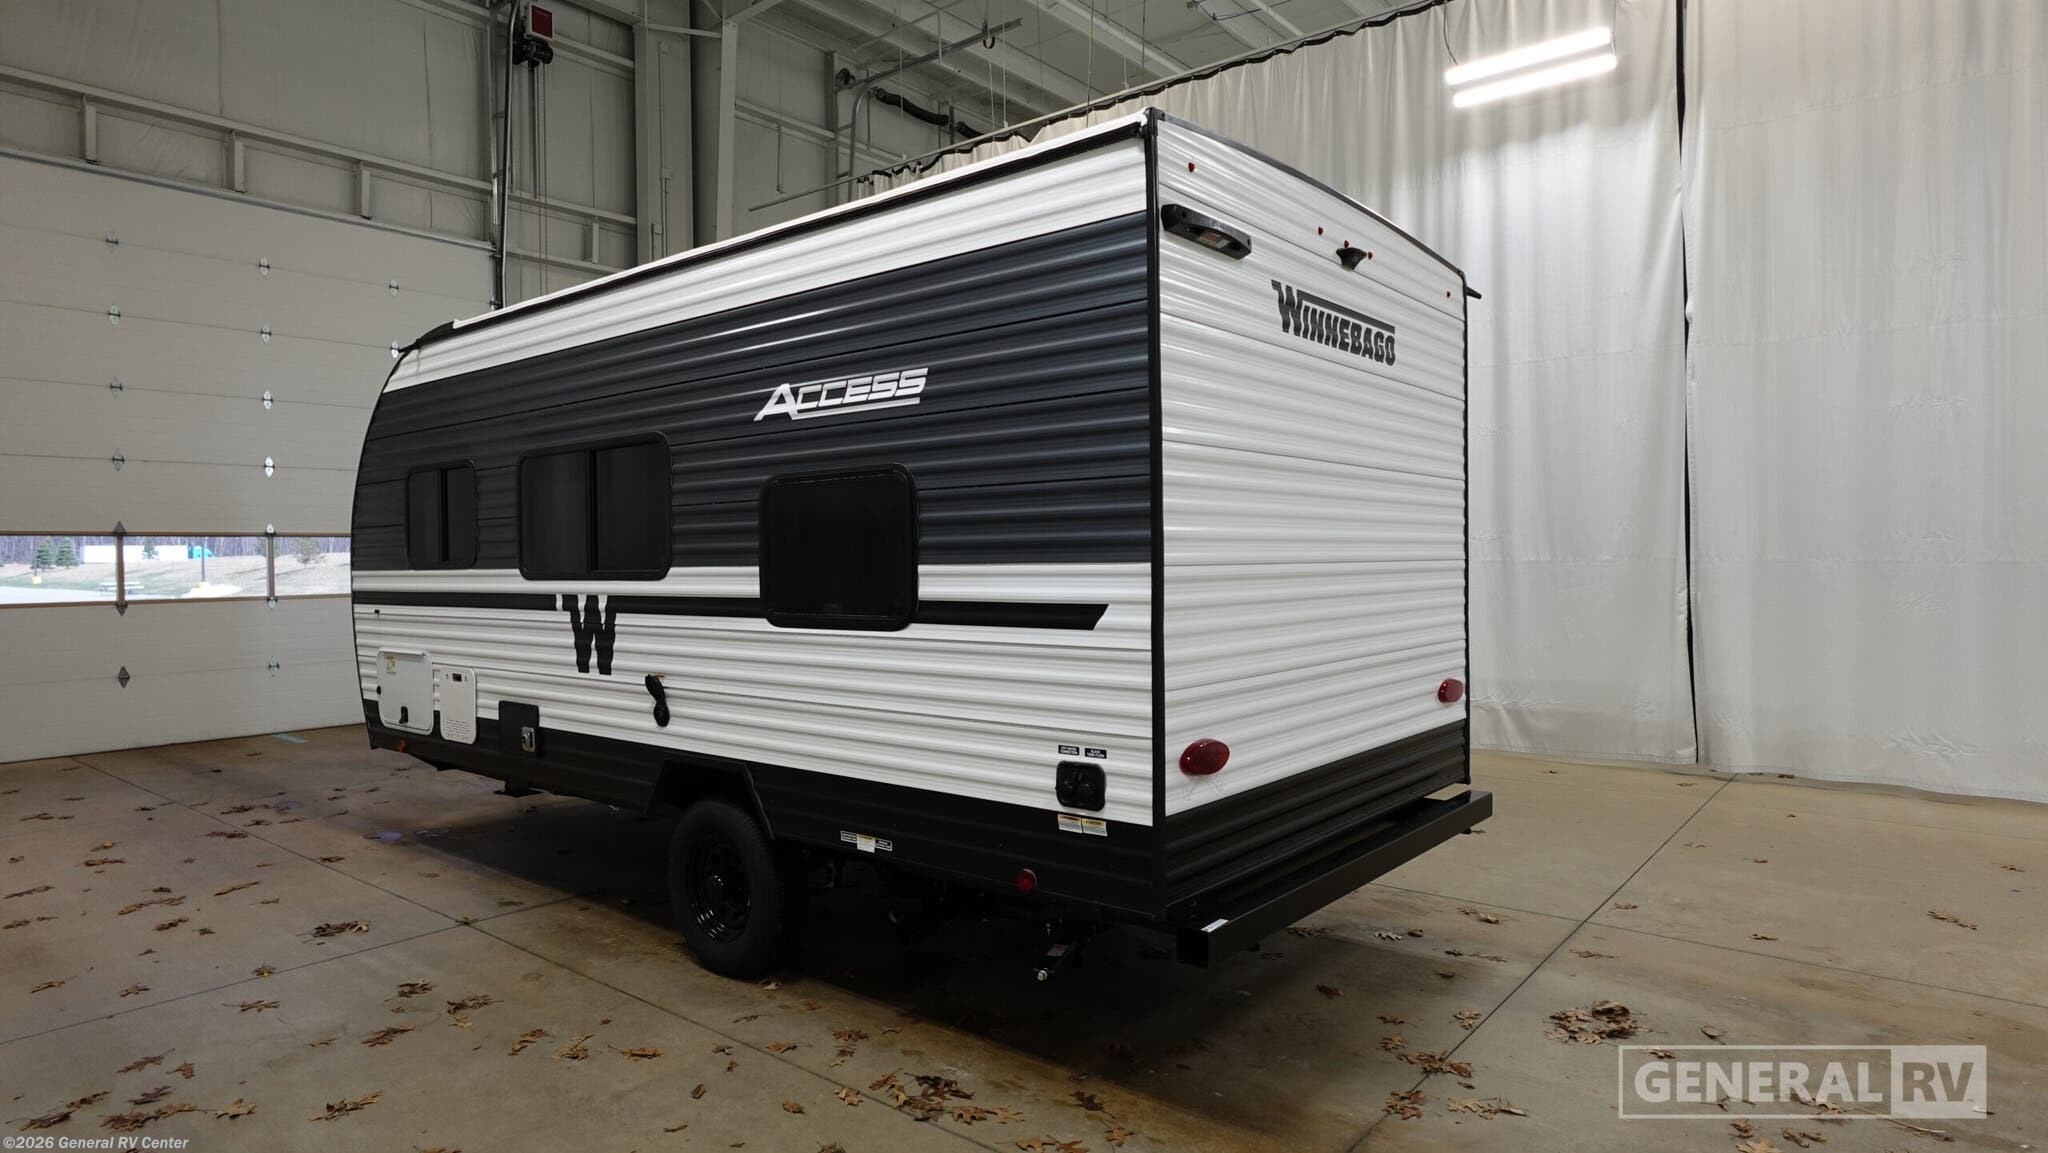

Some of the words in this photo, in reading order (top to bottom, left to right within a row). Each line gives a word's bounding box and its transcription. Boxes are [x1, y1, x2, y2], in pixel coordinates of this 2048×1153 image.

[1271, 279, 1396, 366] WINNEBAGO
[753, 367, 928, 421] ACCESS
[562, 594, 616, 675] W
